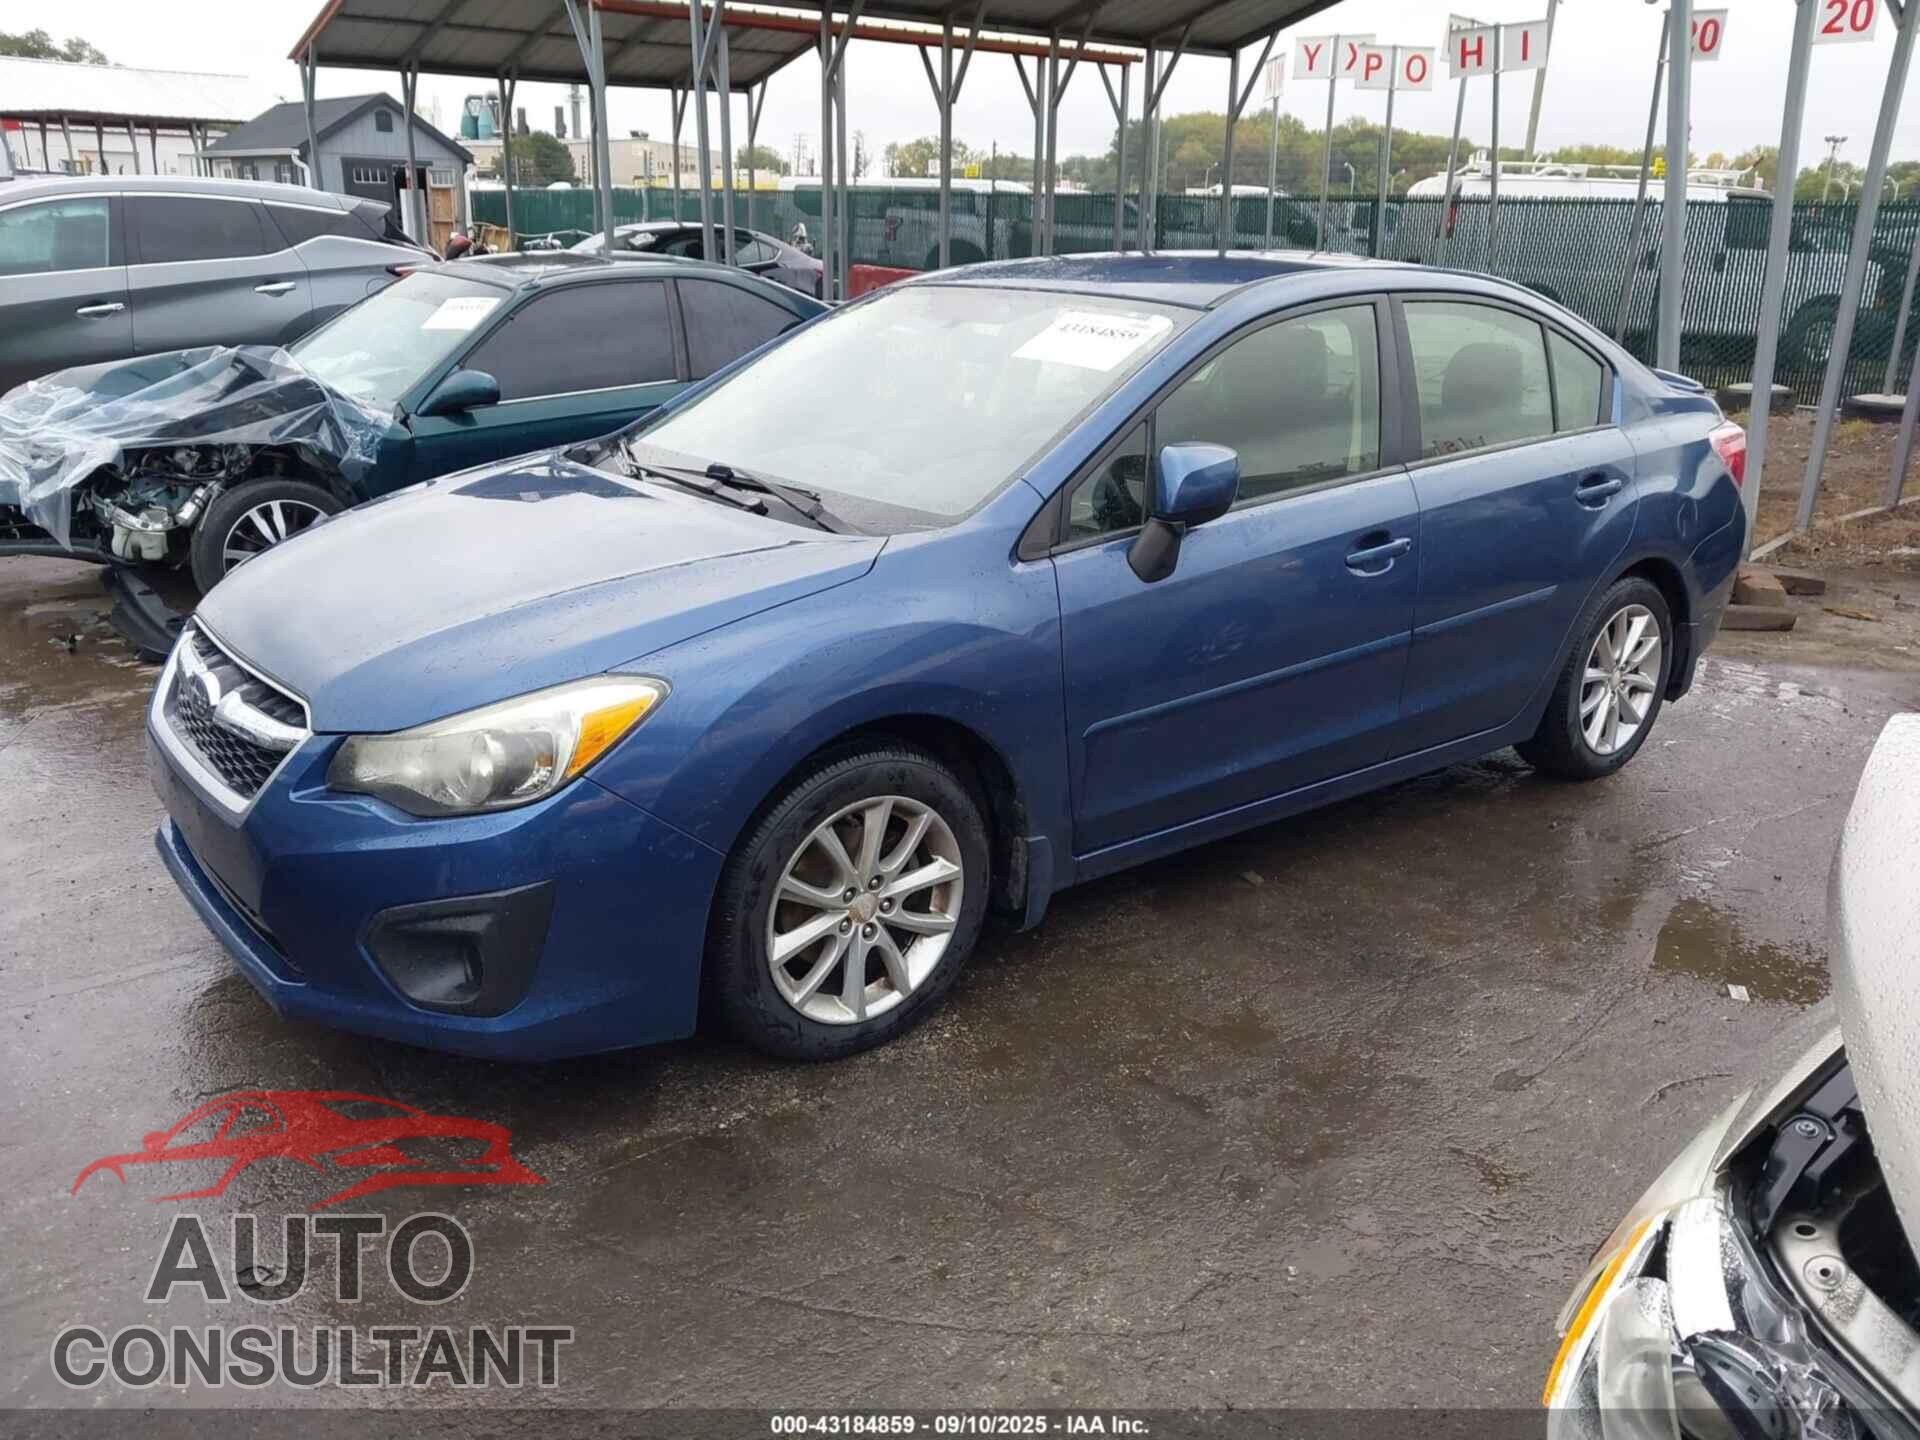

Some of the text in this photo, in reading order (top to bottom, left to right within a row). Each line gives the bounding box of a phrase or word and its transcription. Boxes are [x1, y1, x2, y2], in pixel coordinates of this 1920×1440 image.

[1821, 0, 1875, 34] 20
[1460, 35, 1483, 68] H
[1691, 18, 1720, 53] 0
[1304, 43, 1322, 71] Y
[1364, 53, 1383, 81] P
